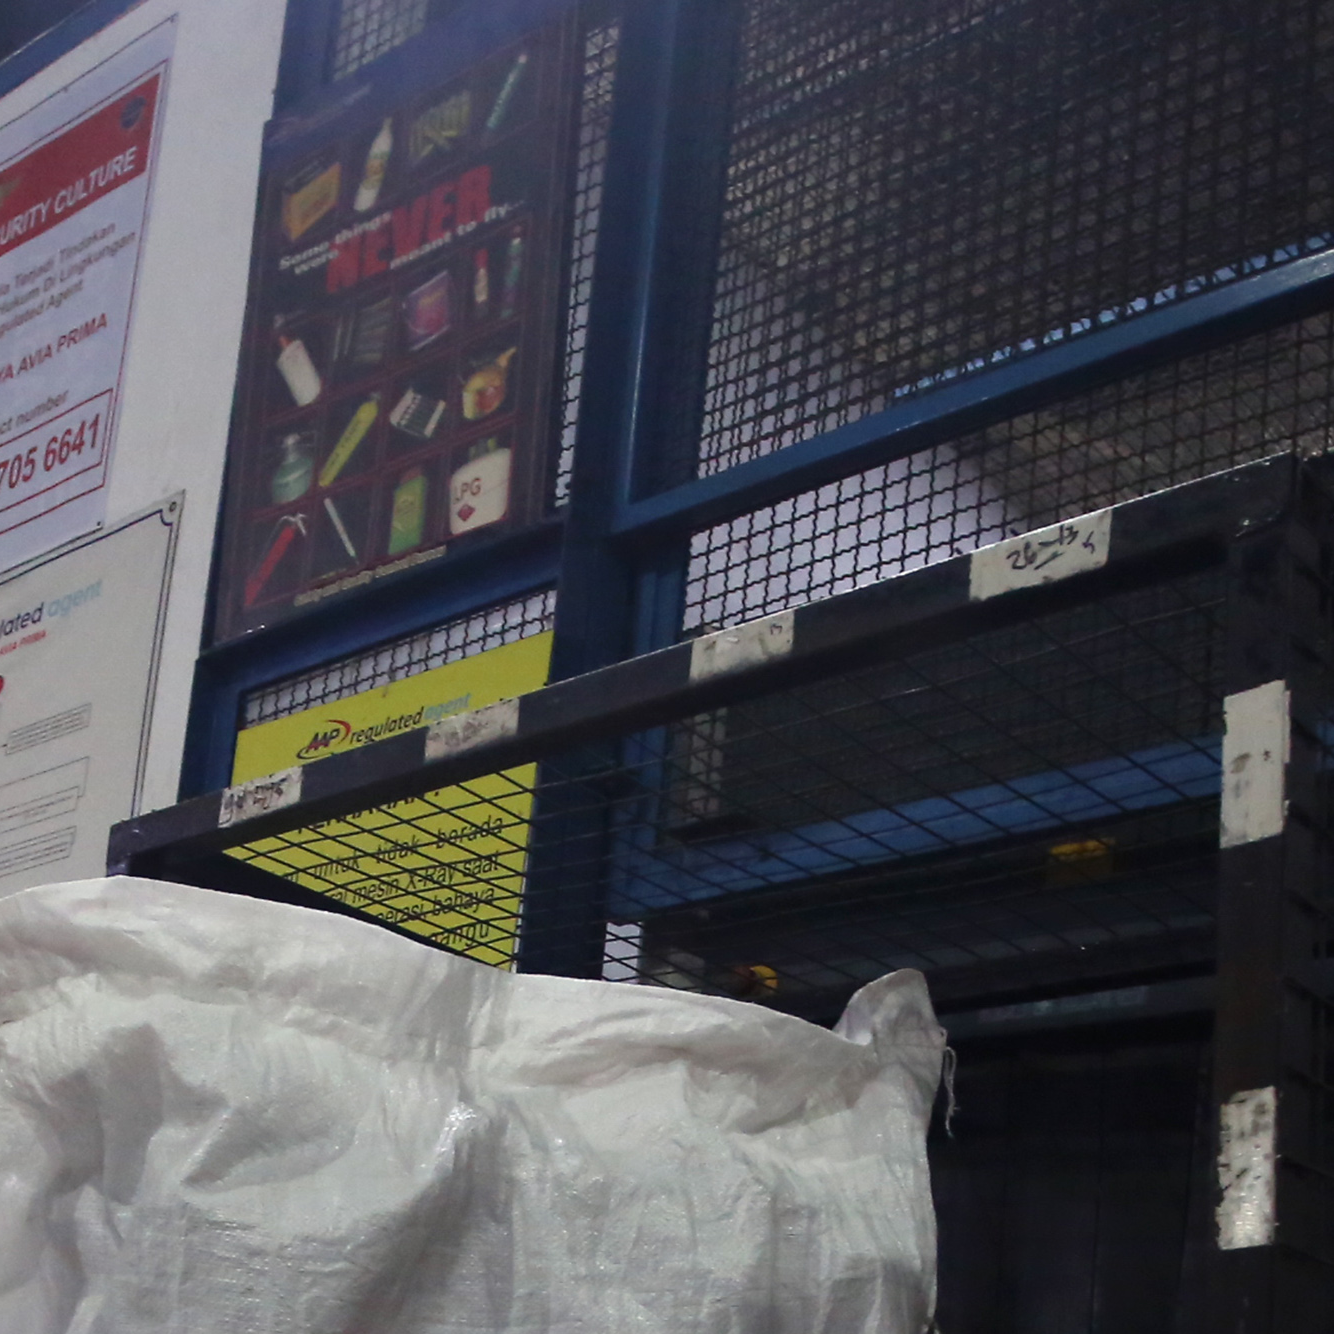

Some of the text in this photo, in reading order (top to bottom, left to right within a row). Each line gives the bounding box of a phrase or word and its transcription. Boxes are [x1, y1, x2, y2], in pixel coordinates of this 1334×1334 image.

[54, 146, 138, 214] CULTURE
[326, 165, 493, 294] NEVER
[17, 344, 53, 376] AVIA
[57, 313, 108, 353] PRIMA
[44, 413, 100, 472] 6641
[47, 578, 103, 617] agent
[349, 706, 425, 746] regulated
[353, 878, 399, 904] mesin
